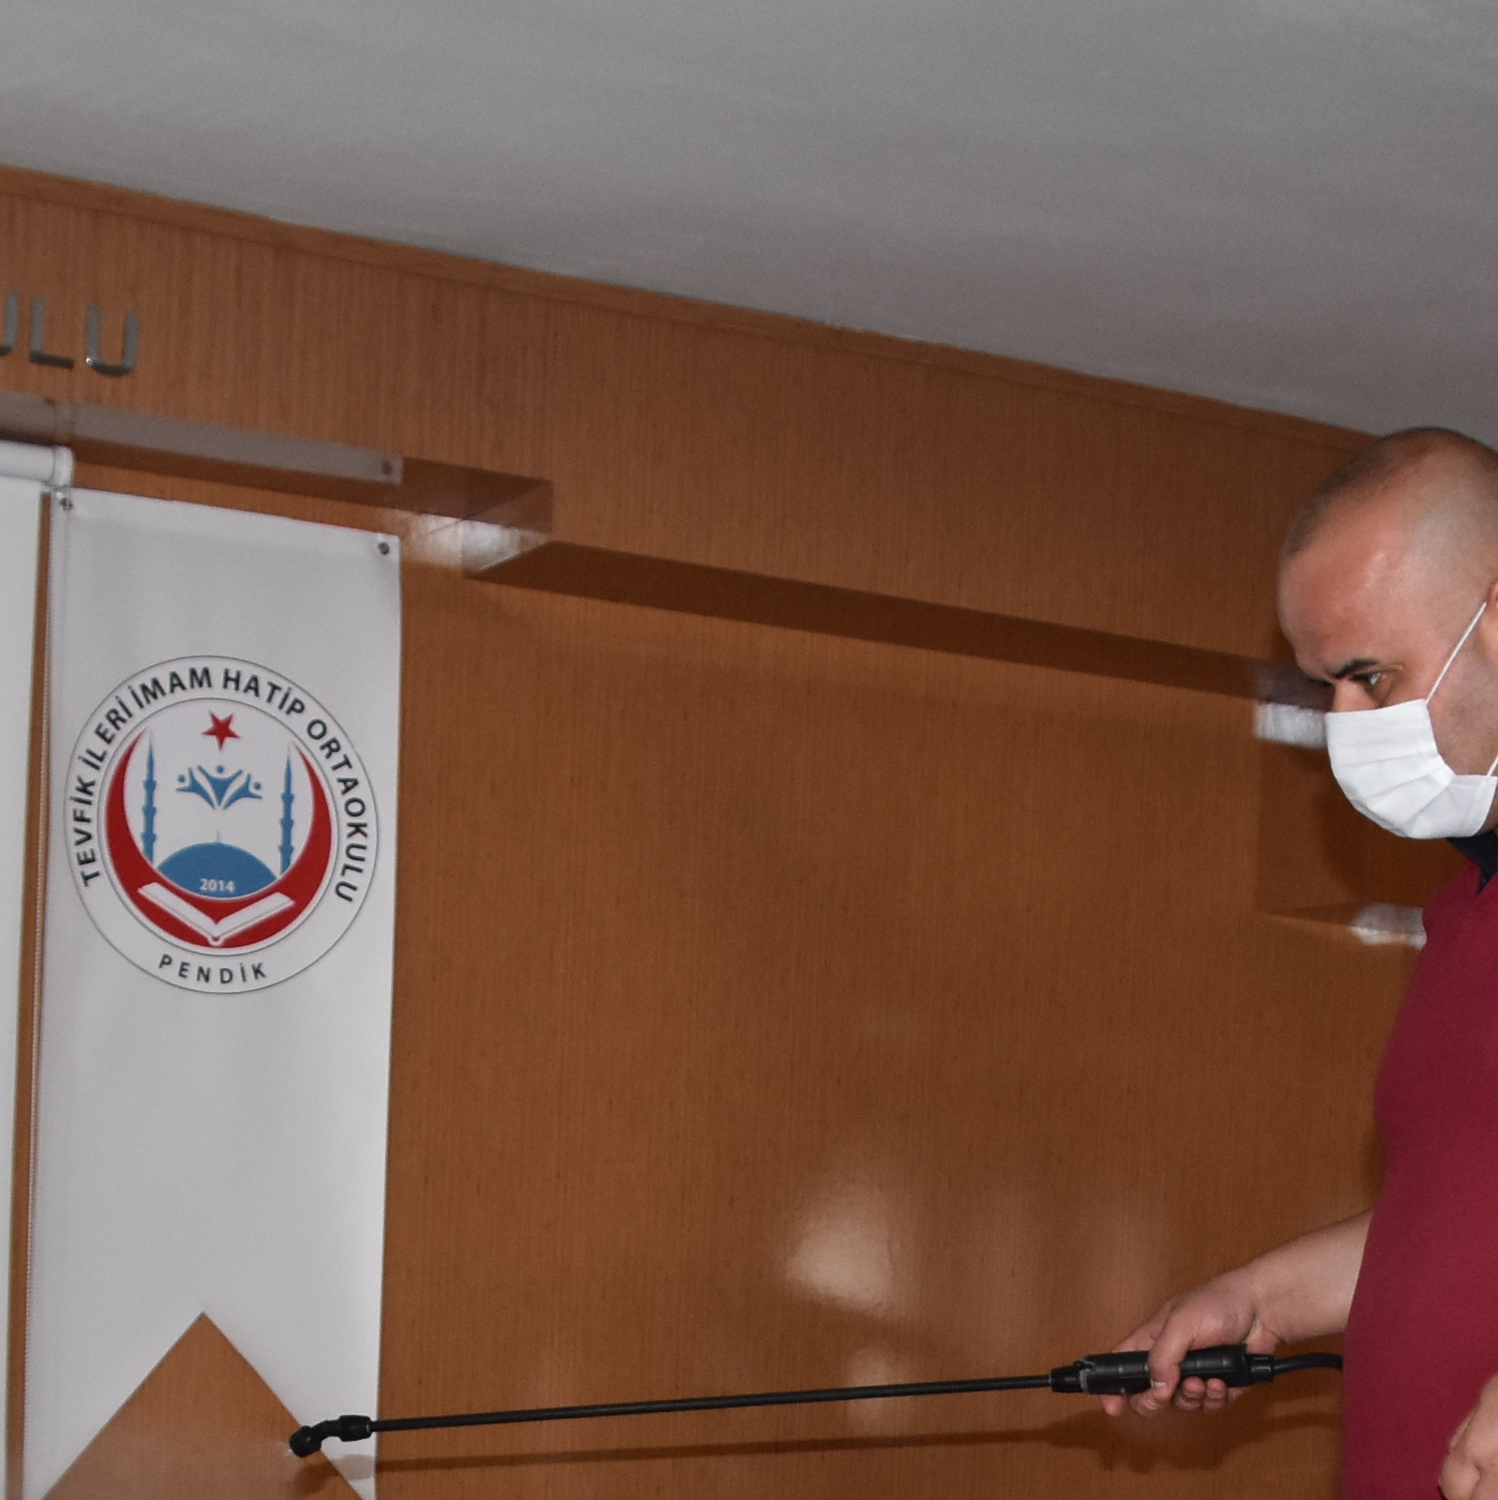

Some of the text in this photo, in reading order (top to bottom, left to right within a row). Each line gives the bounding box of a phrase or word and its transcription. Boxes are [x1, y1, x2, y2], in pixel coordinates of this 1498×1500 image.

[69, 776, 100, 887] TEVFİK
[127, 666, 213, 709] İMAM
[222, 668, 305, 717] HATİP
[306, 718, 369, 903] ORTAOKULU
[199, 877, 236, 893] 2014
[158, 954, 268, 984] PENDİK
